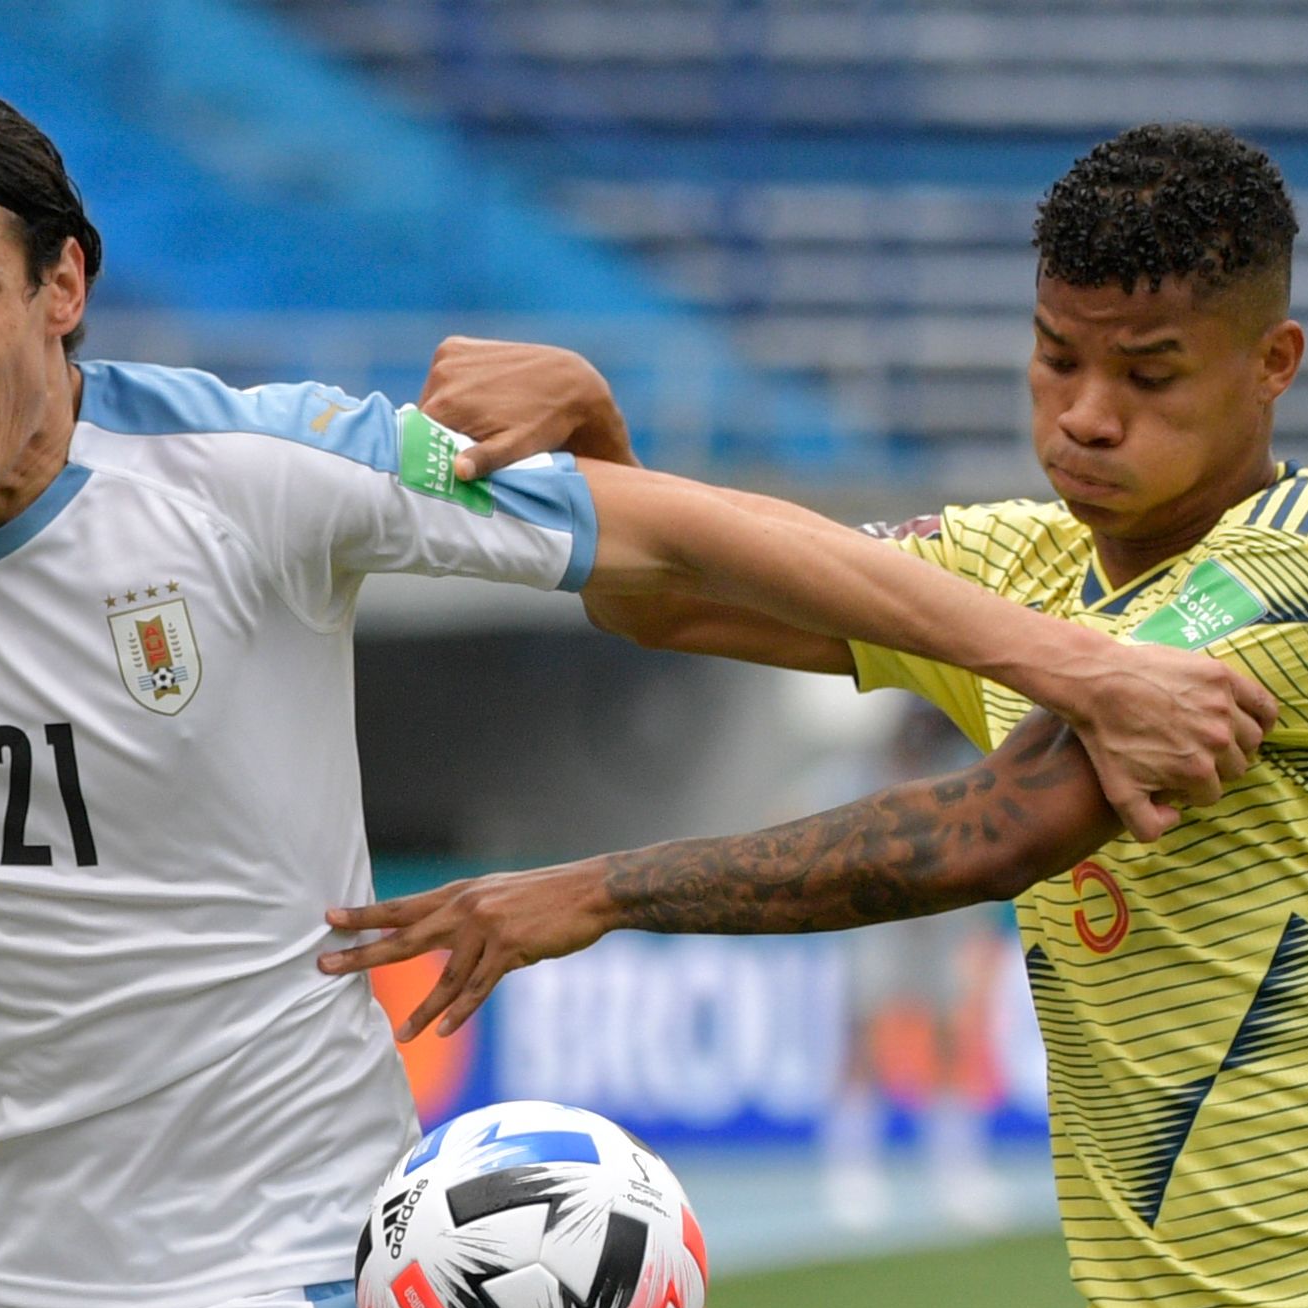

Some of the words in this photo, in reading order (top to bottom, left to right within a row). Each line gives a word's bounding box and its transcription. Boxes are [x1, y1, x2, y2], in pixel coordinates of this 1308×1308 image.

[424, 427, 440, 488] LIVIN
[435, 434, 453, 492] FOOTBA
[391, 1179, 429, 1260] adidas
